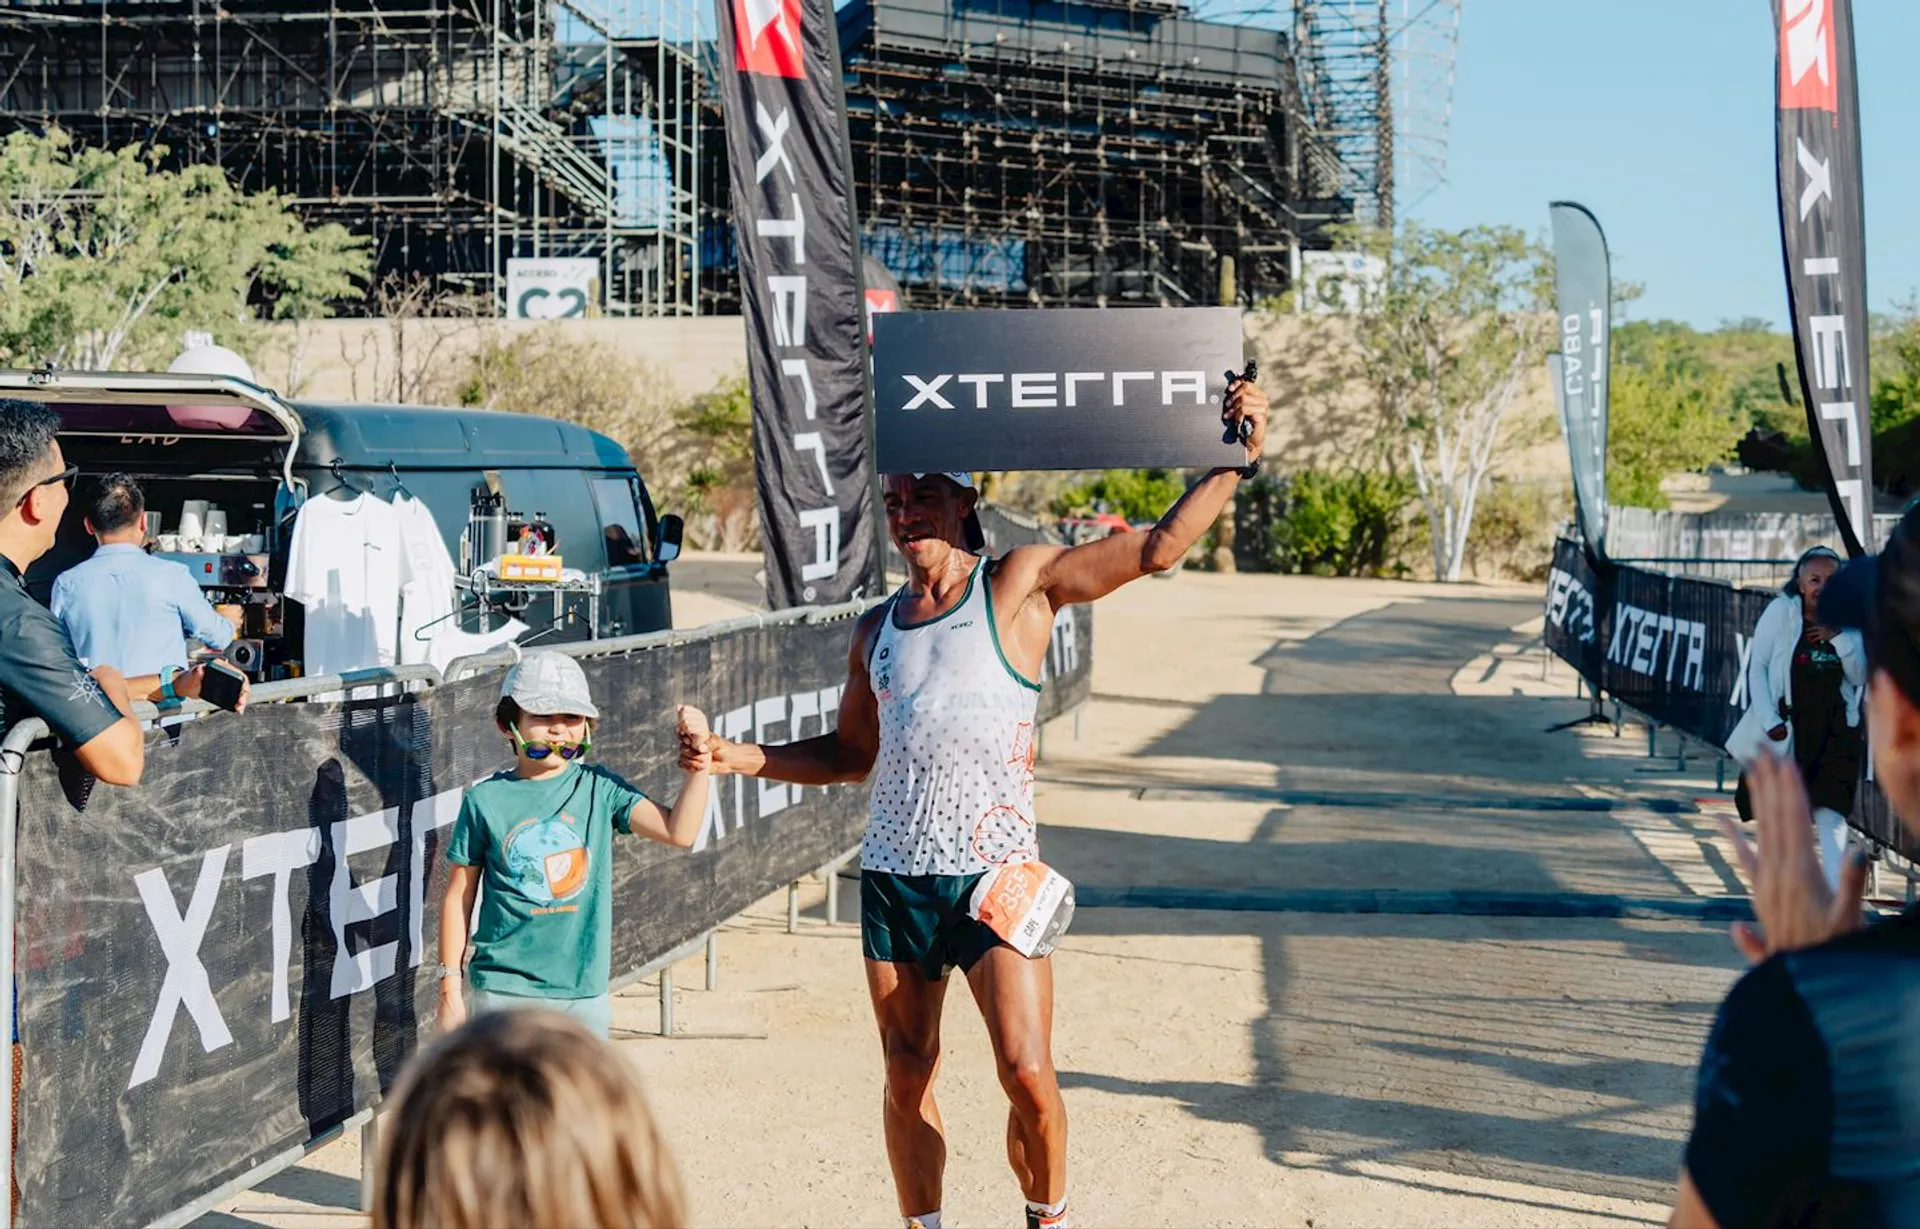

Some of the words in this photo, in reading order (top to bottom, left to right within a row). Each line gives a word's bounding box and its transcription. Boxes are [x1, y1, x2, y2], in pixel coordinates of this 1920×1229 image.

[518, 288, 586, 318] C2
[1797, 137, 1866, 547] XTERR
[901, 370, 1206, 411] XTERRA
[1607, 602, 1706, 691] XTERRA
[127, 784, 466, 1090] XTER
